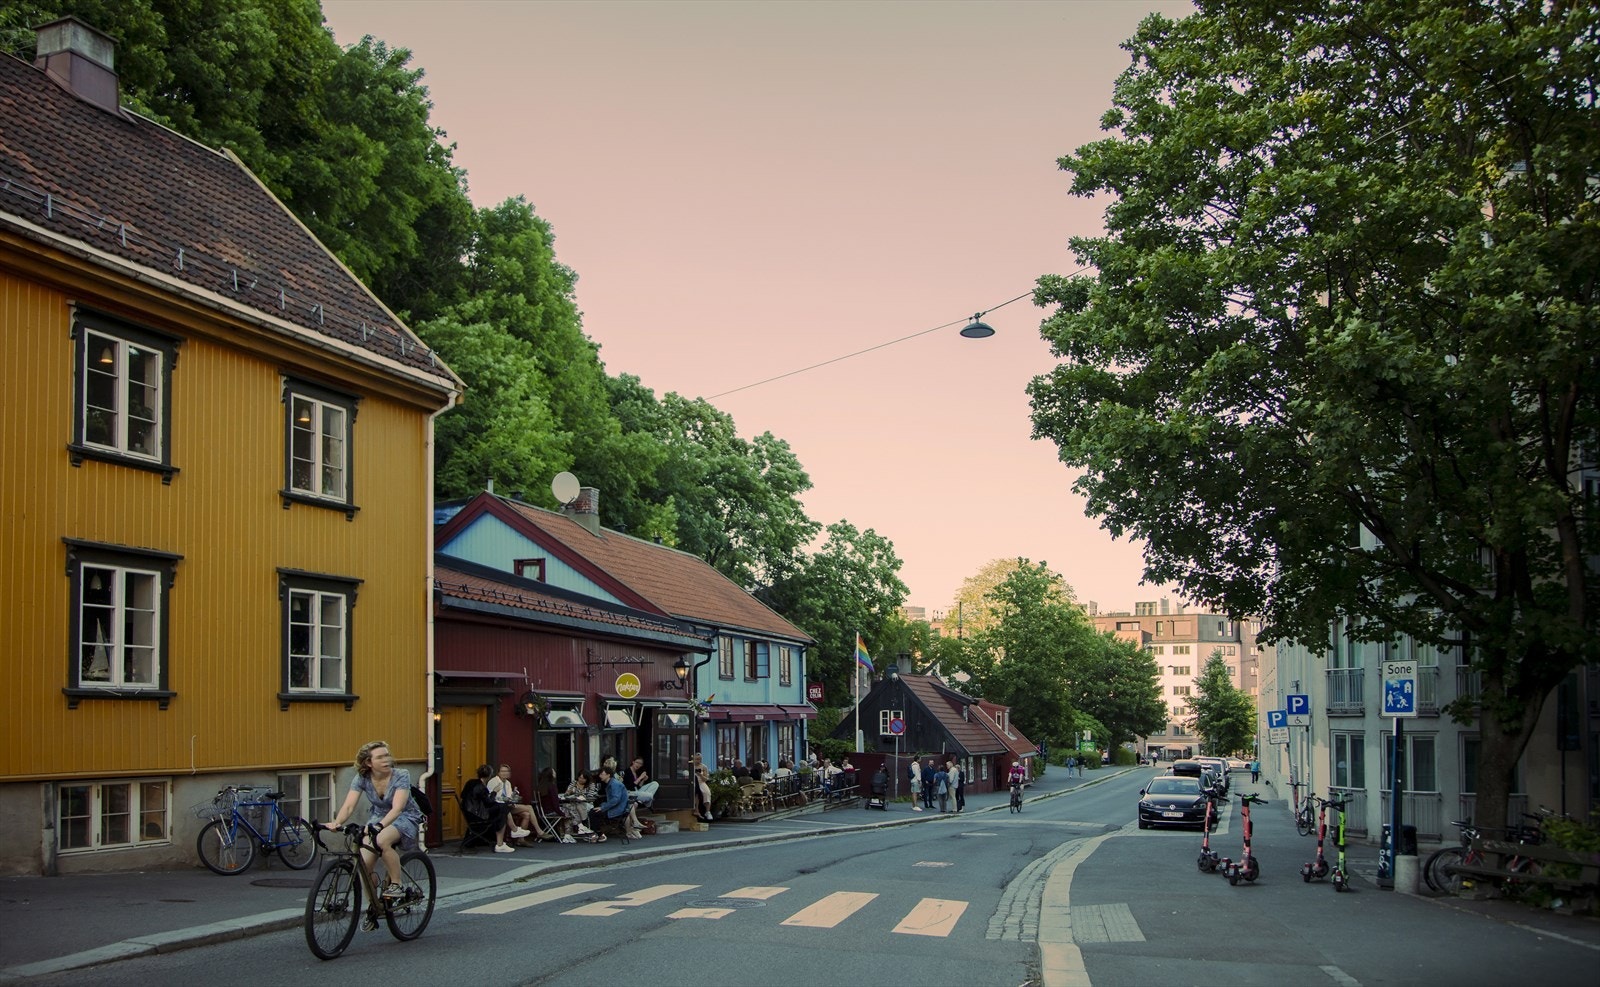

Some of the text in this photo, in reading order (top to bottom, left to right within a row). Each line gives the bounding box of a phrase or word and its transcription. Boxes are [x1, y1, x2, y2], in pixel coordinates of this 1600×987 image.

[1387, 664, 1412, 675] Sone
[1292, 696, 1304, 713] P
[1271, 712, 1283, 727] P
